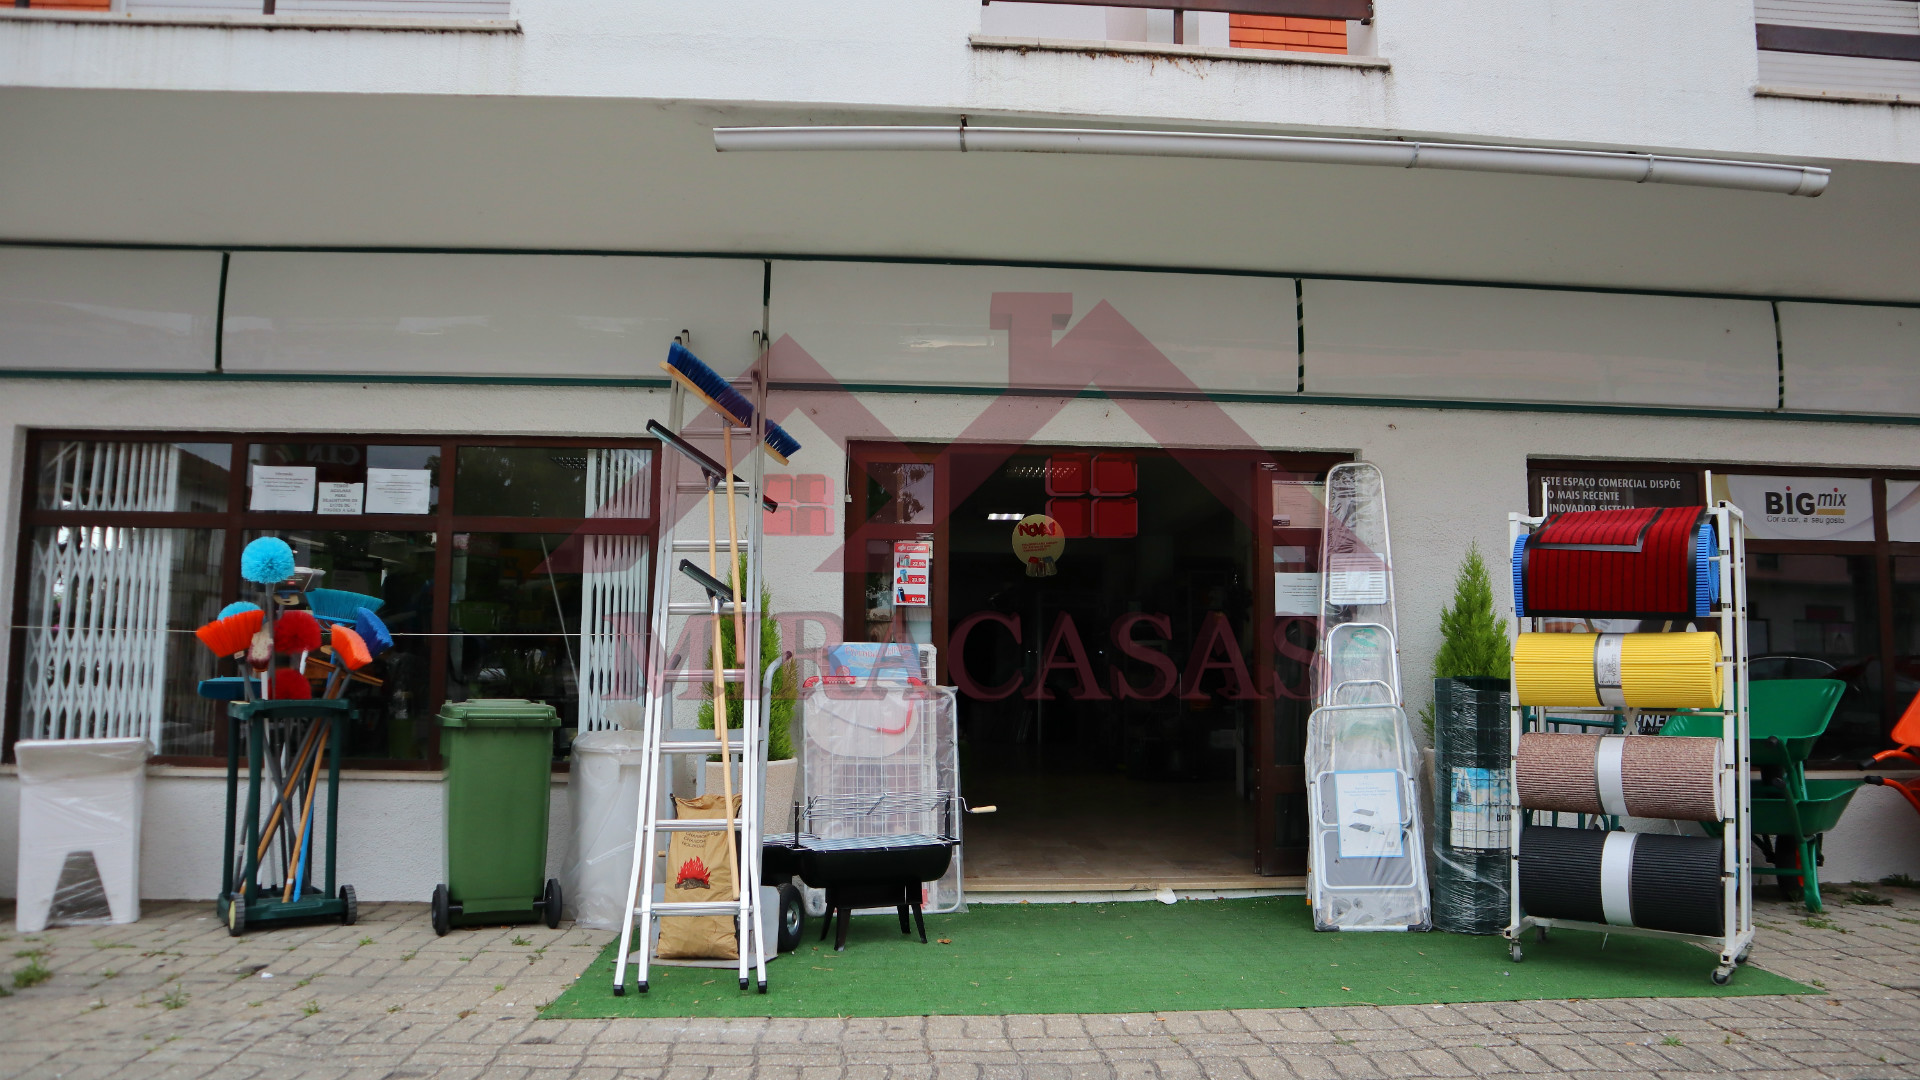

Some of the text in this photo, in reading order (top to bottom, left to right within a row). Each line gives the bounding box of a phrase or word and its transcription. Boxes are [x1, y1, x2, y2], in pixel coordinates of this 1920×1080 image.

[1563, 477, 1595, 488] ESPAÇO
[1599, 478, 1647, 488] COMERCIAL
[1650, 479, 1680, 489] DISPÕE
[1558, 491, 1580, 499] MAIS
[1583, 491, 1620, 500] RECENTE
[1817, 487, 1847, 506] mix
[1549, 503, 1596, 513] INOVADOR
